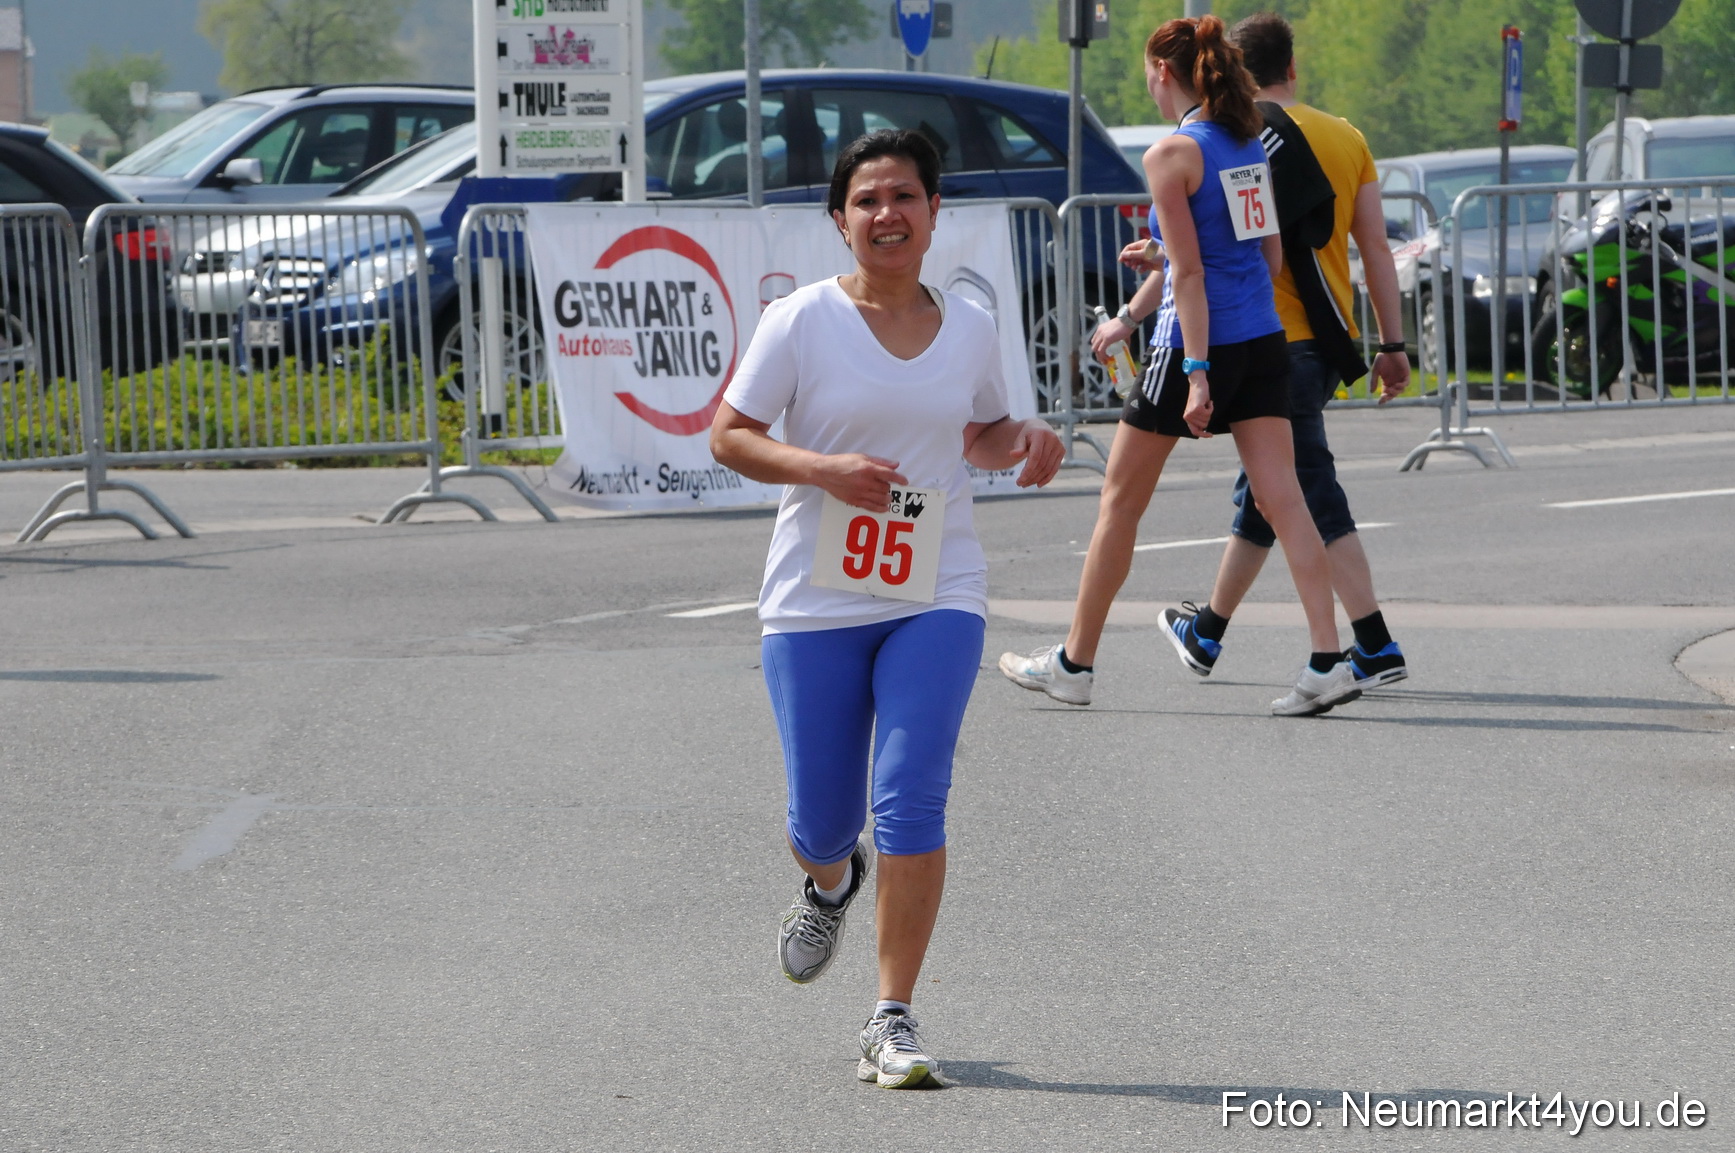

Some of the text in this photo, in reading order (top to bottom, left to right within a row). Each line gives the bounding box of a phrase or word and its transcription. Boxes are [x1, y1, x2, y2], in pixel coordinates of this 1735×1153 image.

[513, 82, 566, 116] THULE
[1229, 169, 1252, 181] MEYER
[1237, 187, 1265, 230] 75
[554, 279, 713, 328] GERHART &
[558, 333, 633, 356] Autohaus
[633, 330, 721, 377] JÄNIG
[569, 465, 640, 495] Neumarkt
[842, 515, 915, 586] 95
